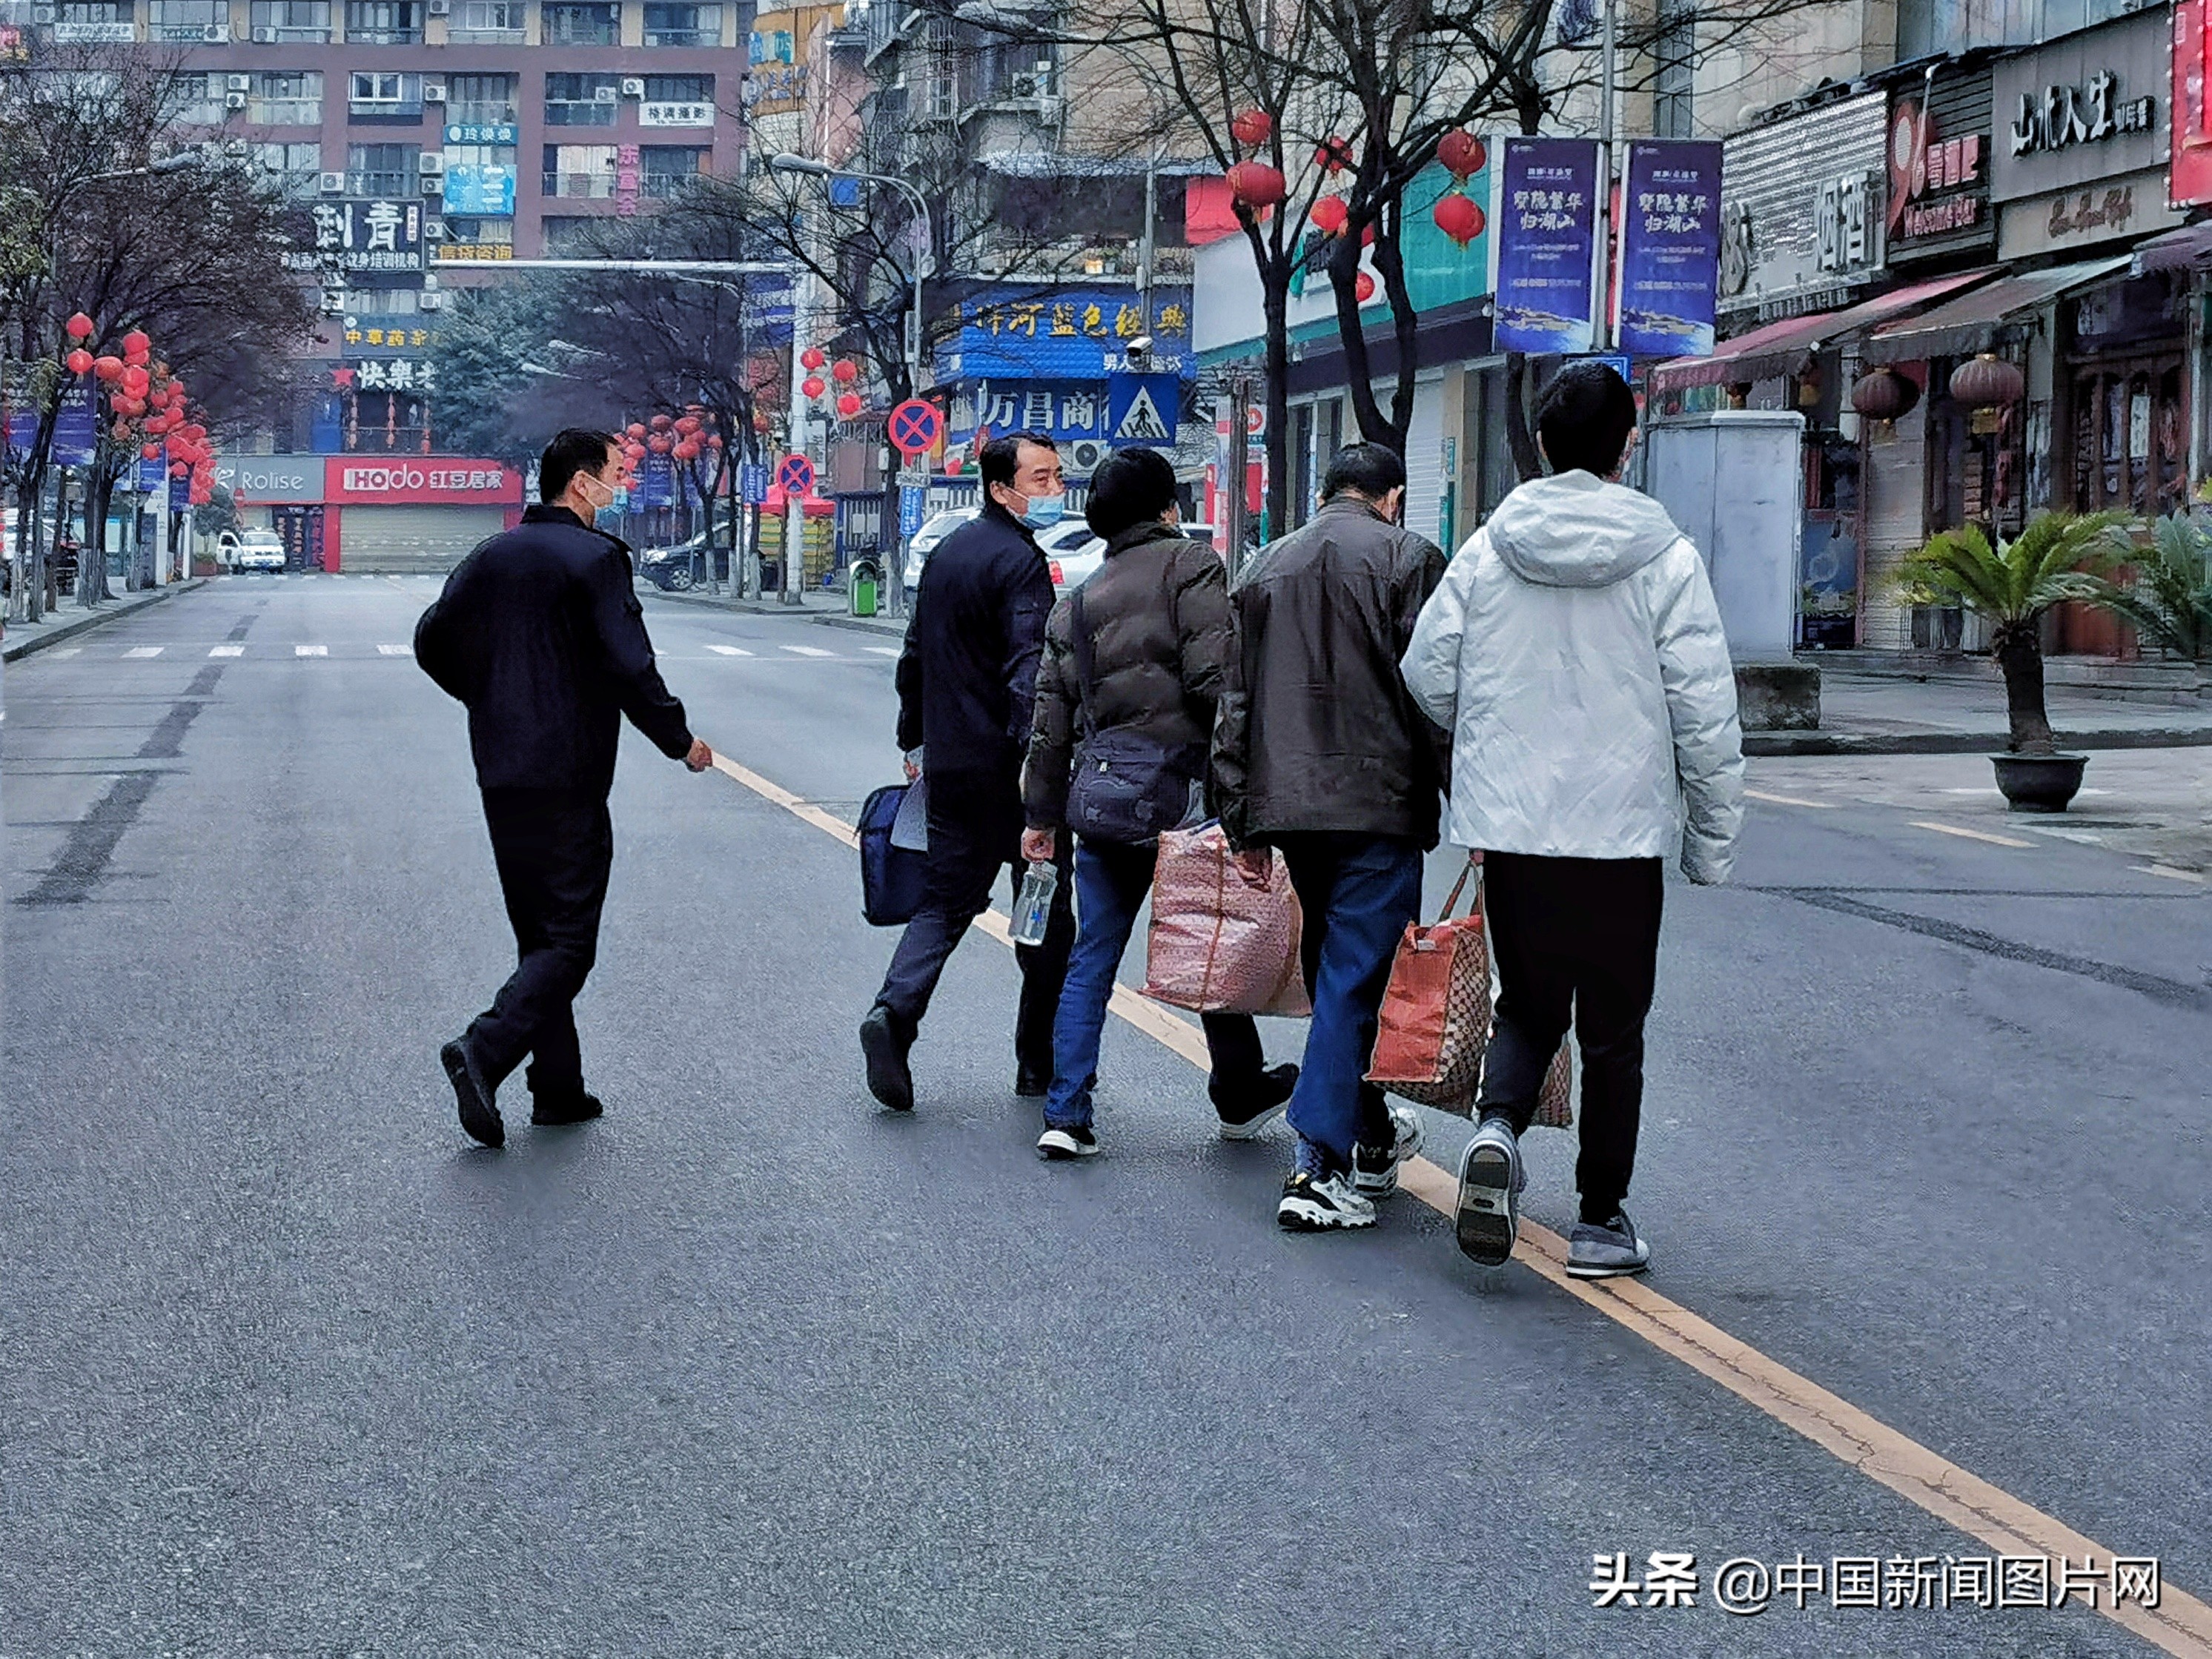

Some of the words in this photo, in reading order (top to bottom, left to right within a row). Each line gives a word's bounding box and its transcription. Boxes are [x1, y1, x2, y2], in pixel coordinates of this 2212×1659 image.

[312, 201, 403, 251] 刺青
[429, 470, 503, 490] 红豆居家
